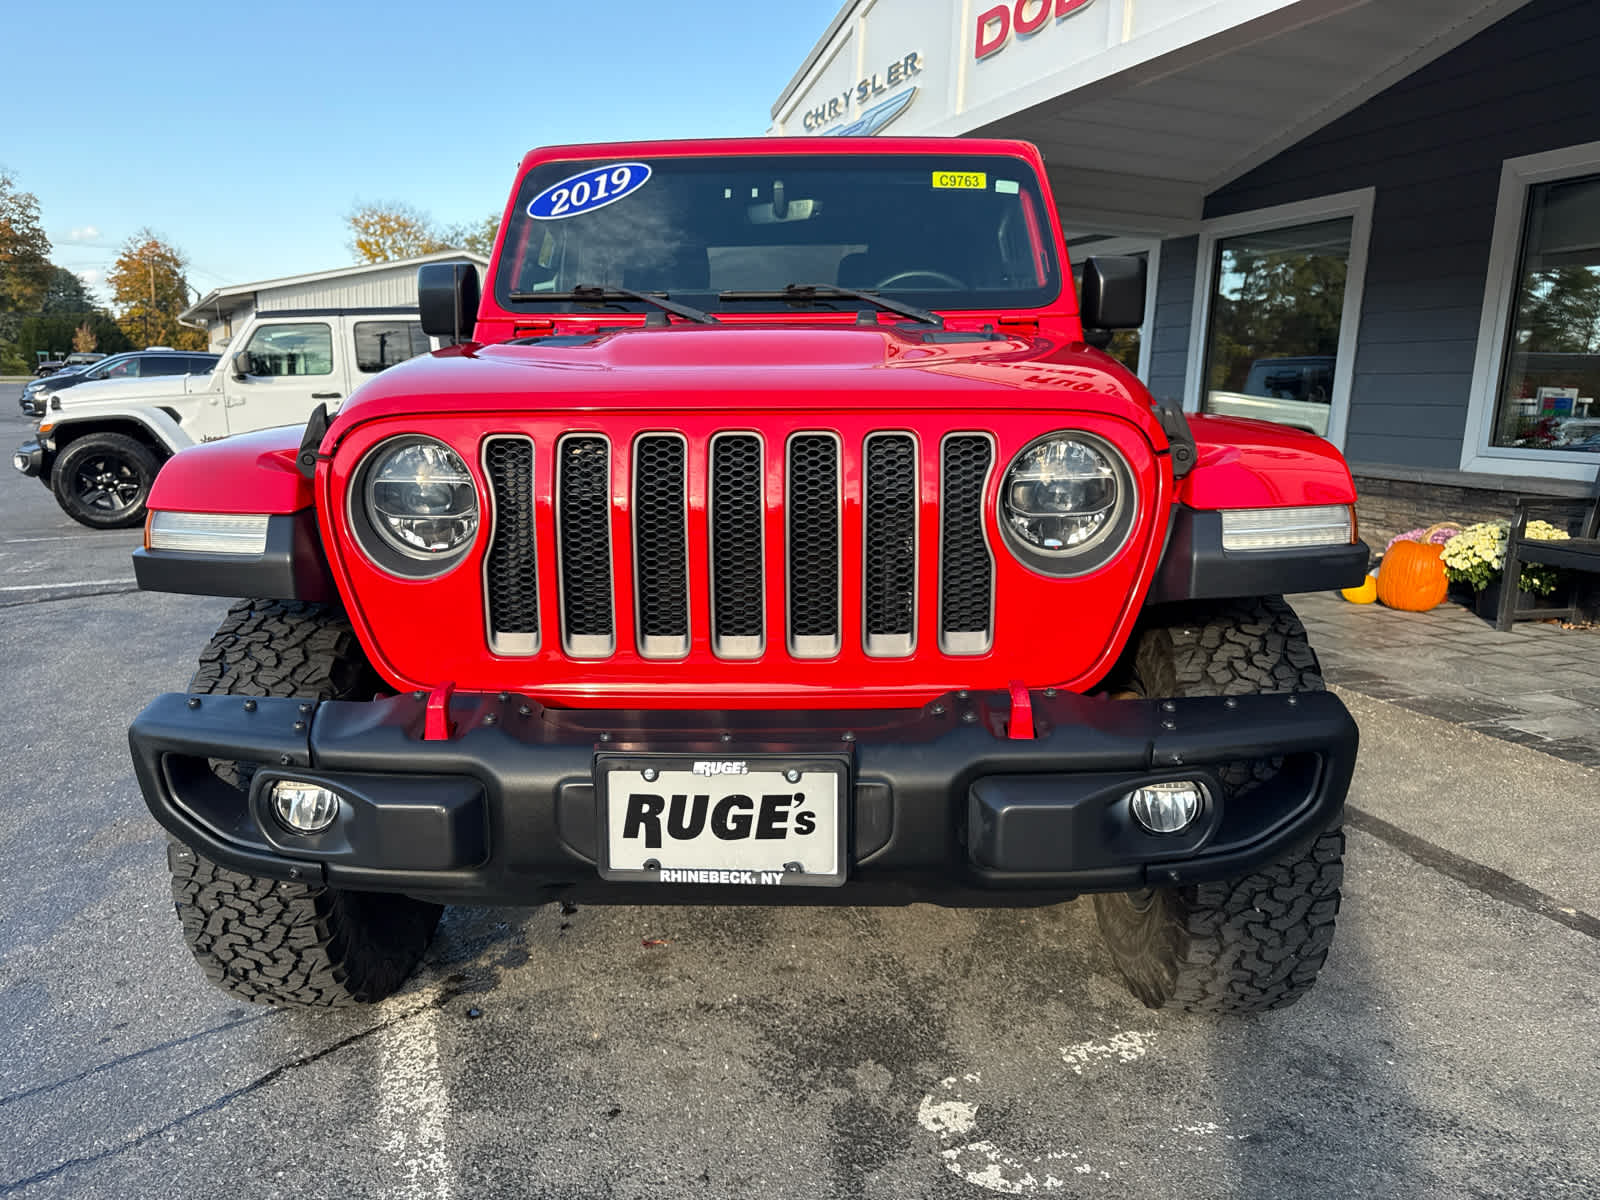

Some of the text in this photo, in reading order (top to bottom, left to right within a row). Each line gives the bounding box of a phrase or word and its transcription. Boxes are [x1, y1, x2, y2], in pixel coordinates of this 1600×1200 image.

[803, 52, 921, 130] CHRYSLER
[551, 167, 631, 215] 2019
[939, 174, 980, 188] C9763
[623, 793, 816, 848] RUGE's
[660, 869, 784, 885] RHINEBECK, NY
